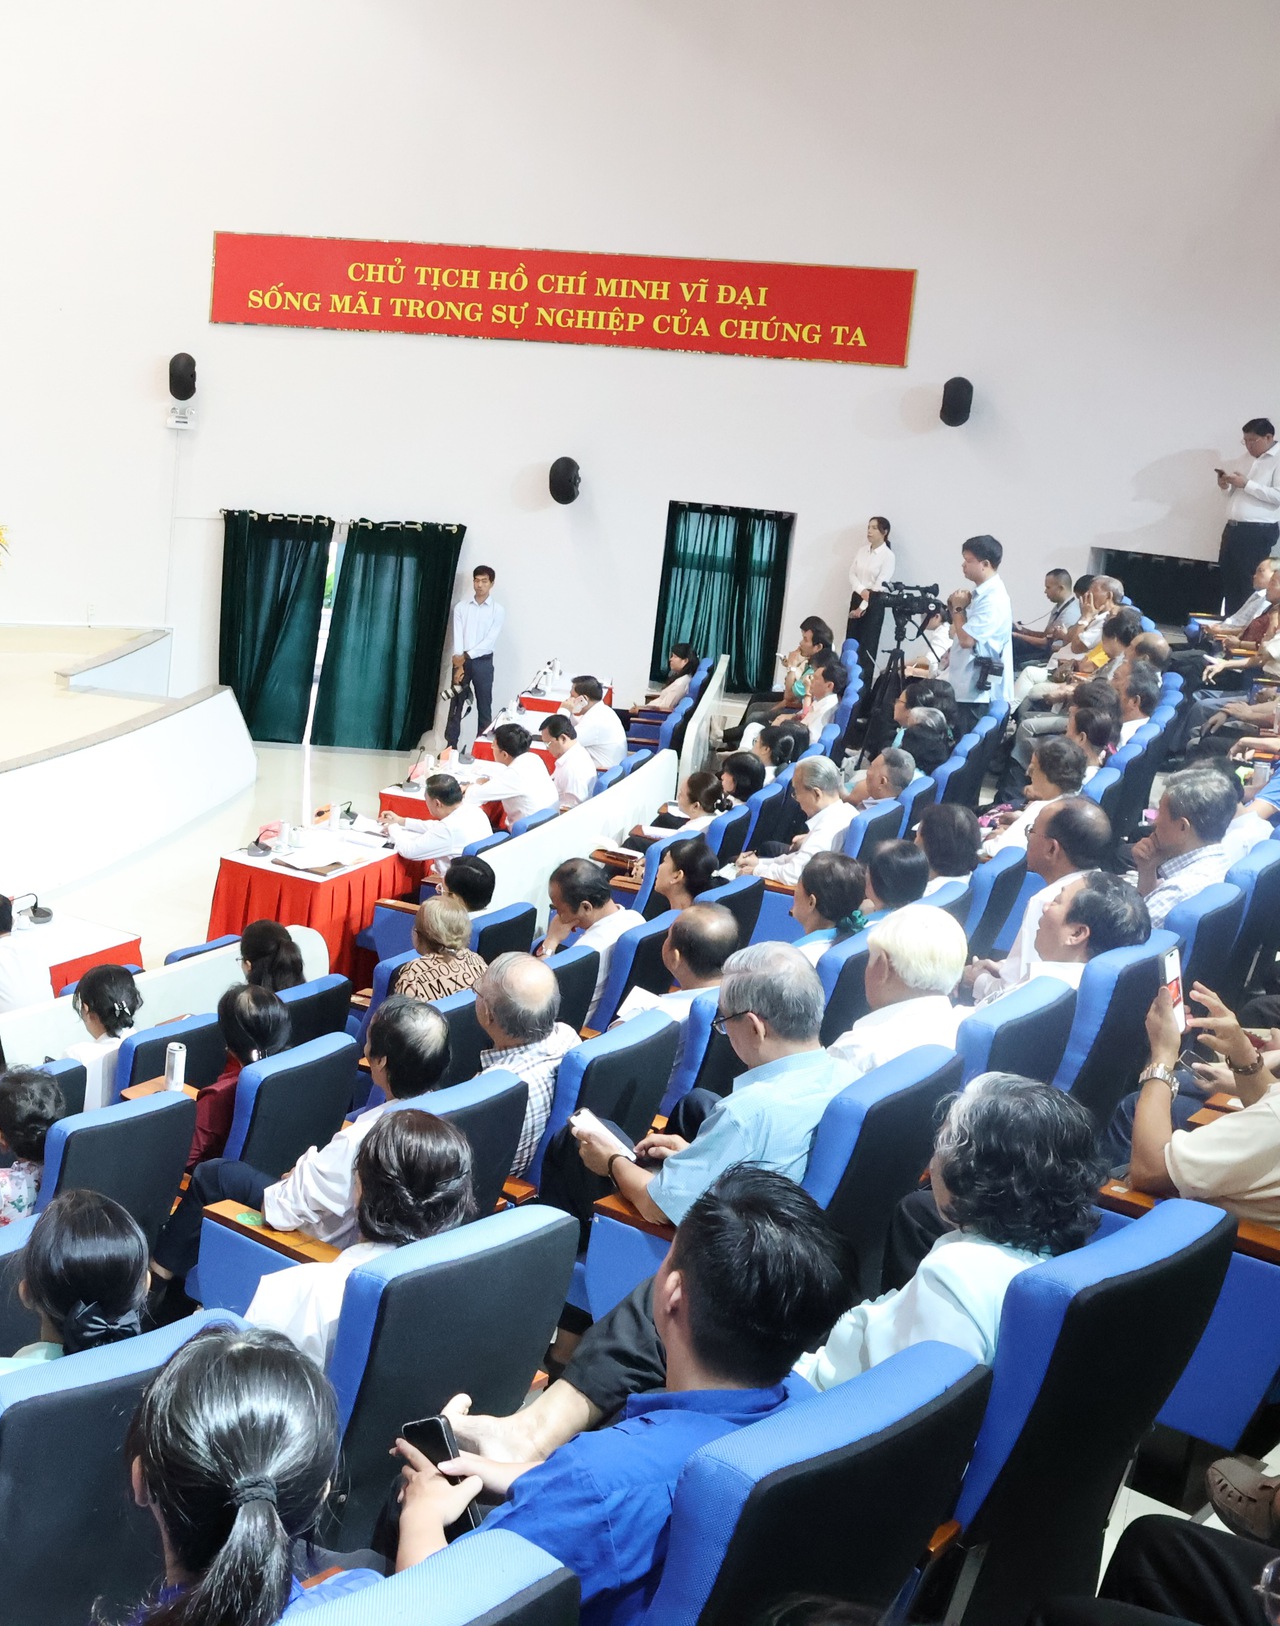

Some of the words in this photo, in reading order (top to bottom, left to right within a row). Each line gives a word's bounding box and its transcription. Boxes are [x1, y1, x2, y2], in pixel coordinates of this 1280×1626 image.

[347, 257, 406, 285] CHỦ
[414, 266, 480, 291] TỊCH
[487, 262, 529, 292] HỒ
[536, 270, 587, 296] CHÍ
[594, 277, 671, 302] MINH
[679, 278, 710, 303] VĨ
[715, 284, 769, 311] ĐẠI
[247, 282, 321, 312] SỐNG
[328, 291, 383, 316] MÃI
[389, 297, 484, 323] TRONG
[491, 301, 530, 330] SỰ
[535, 306, 645, 336] NGHIỆP
[652, 307, 711, 337] CỦA
[719, 316, 822, 345] CHÚNG
[831, 325, 868, 347] TA
